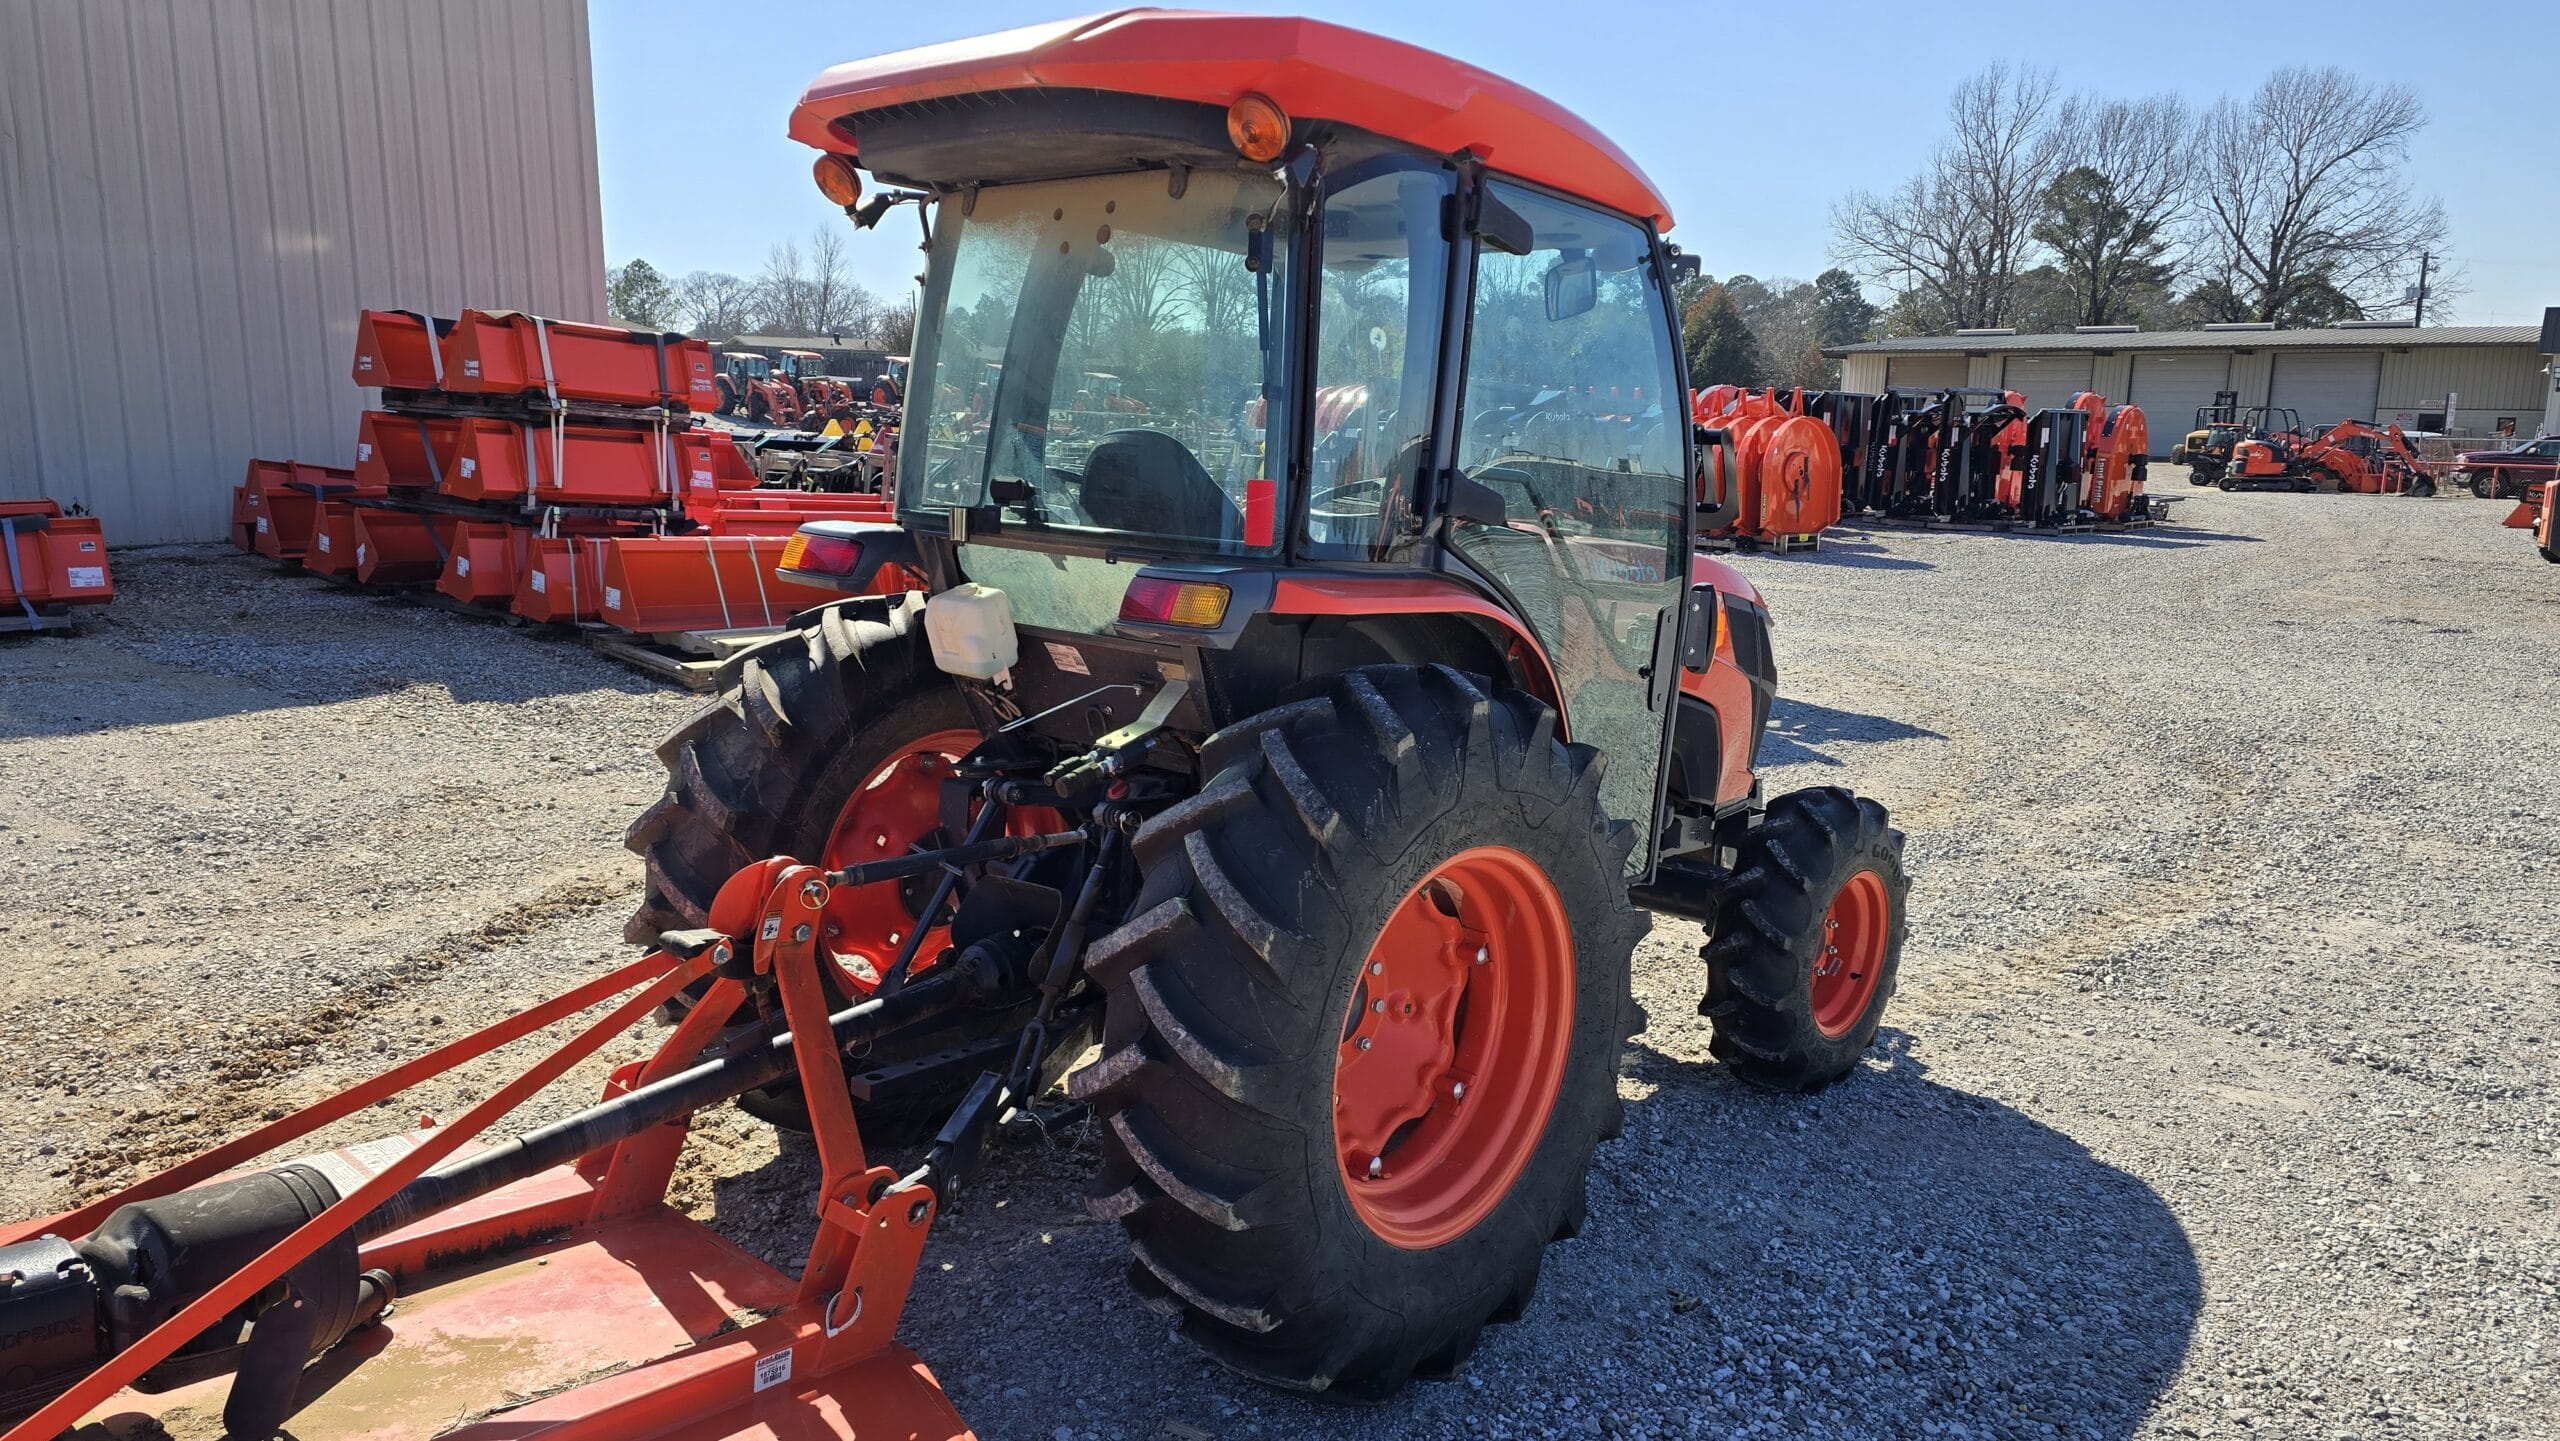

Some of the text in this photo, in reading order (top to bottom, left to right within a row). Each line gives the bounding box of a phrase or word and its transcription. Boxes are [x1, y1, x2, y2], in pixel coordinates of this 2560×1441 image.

[1545, 412, 1571, 422] Kubota
[1876, 445, 1888, 478] Kubota
[1939, 448, 1951, 482] Kubota
[2027, 454, 2040, 490] Kubota
[2093, 457, 2107, 504] Land Pride
